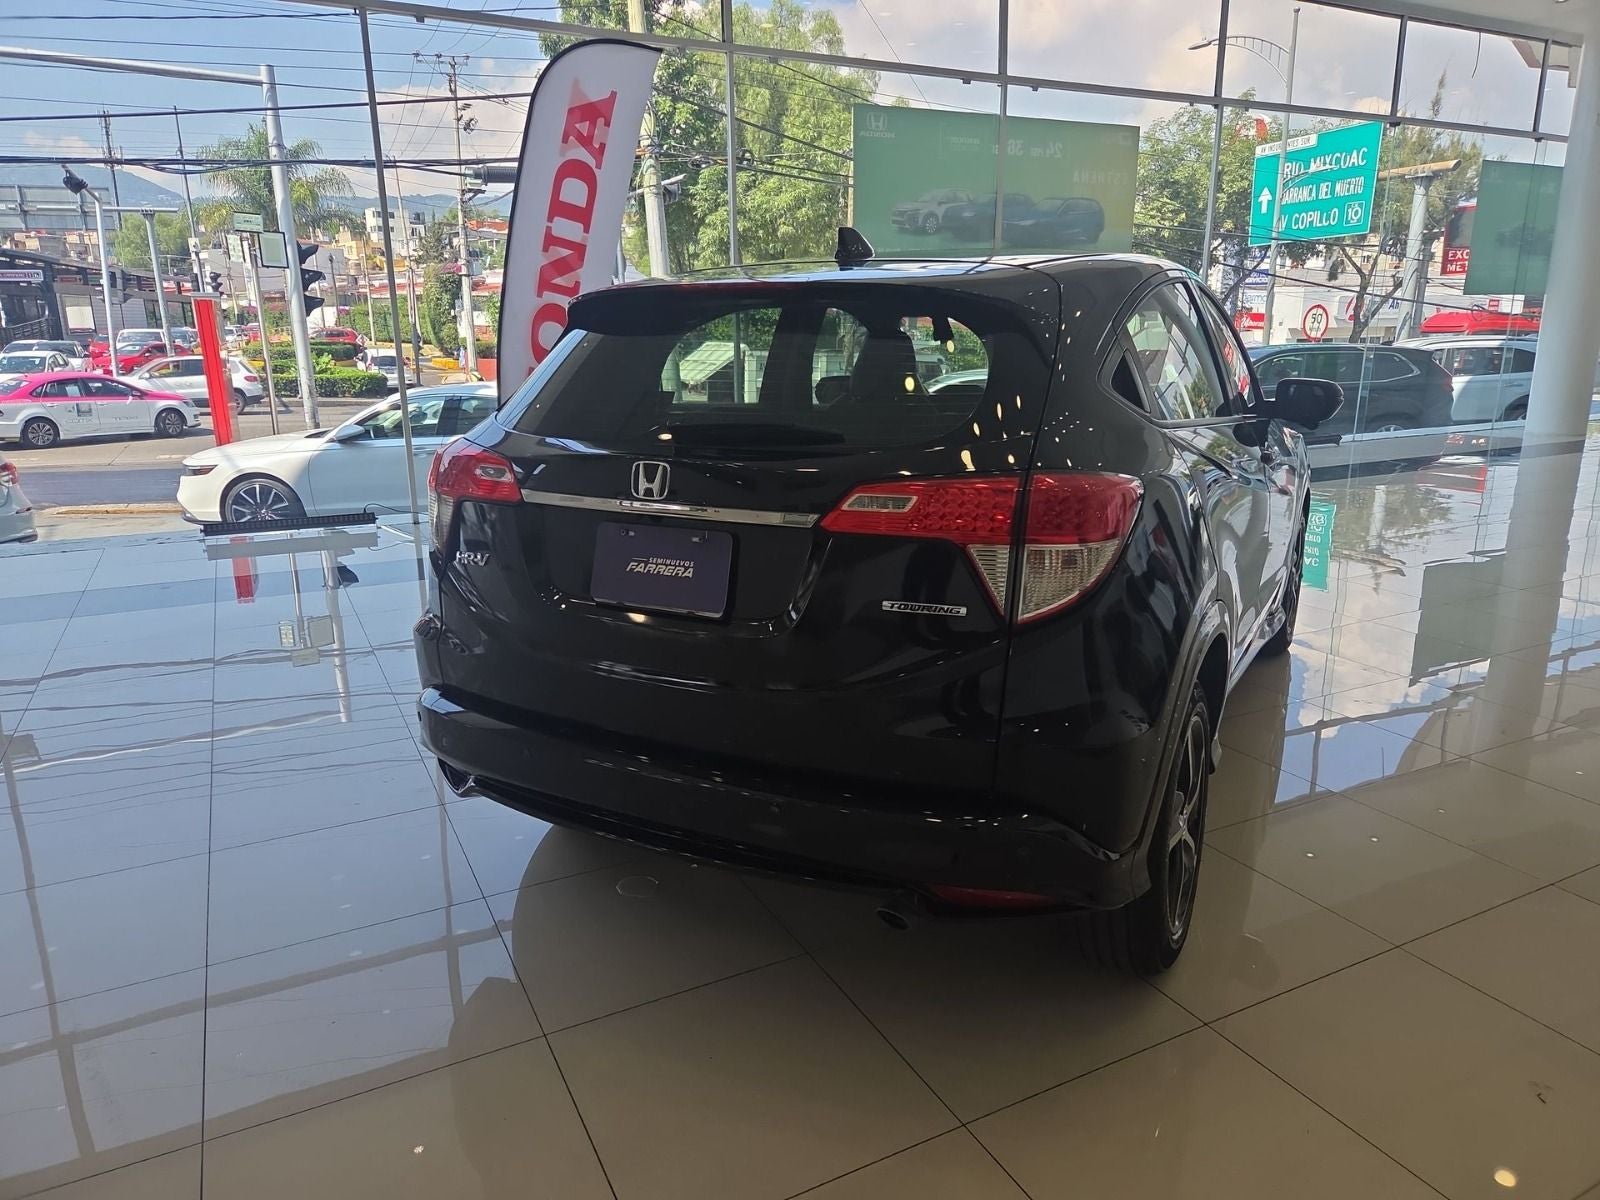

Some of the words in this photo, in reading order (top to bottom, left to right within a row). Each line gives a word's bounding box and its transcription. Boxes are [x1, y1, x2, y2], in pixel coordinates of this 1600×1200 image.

[1309, 147, 1368, 174] MIXCUAC
[1319, 182, 1331, 199] DEL
[1334, 176, 1365, 198] MUERTO
[1347, 207, 1361, 221] 10
[527, 91, 618, 378] ONDA
[1311, 313, 1322, 324] 50
[626, 562, 694, 578] FARRERA
[648, 557, 695, 568] SEMINUEVOS
[888, 602, 962, 615] TOURING
